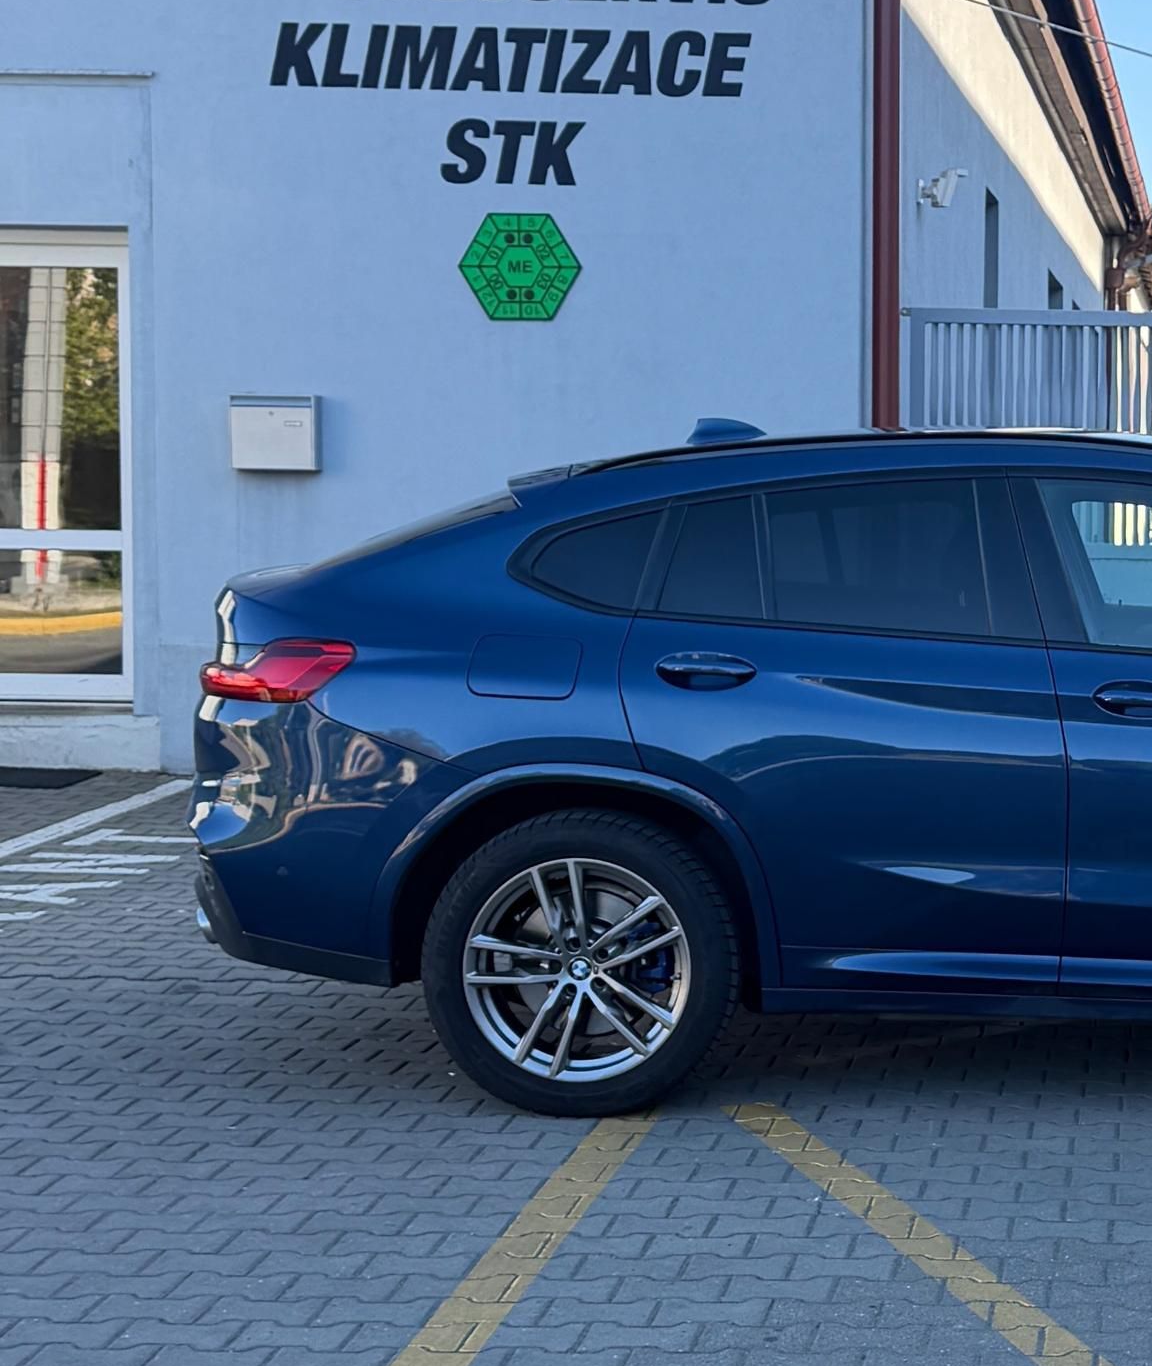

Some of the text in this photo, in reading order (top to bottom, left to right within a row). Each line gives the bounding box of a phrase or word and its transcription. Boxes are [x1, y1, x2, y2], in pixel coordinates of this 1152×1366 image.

[269, 21, 752, 98] KLIMATIZACE
[440, 118, 587, 187] STK
[507, 260, 533, 273] ME
